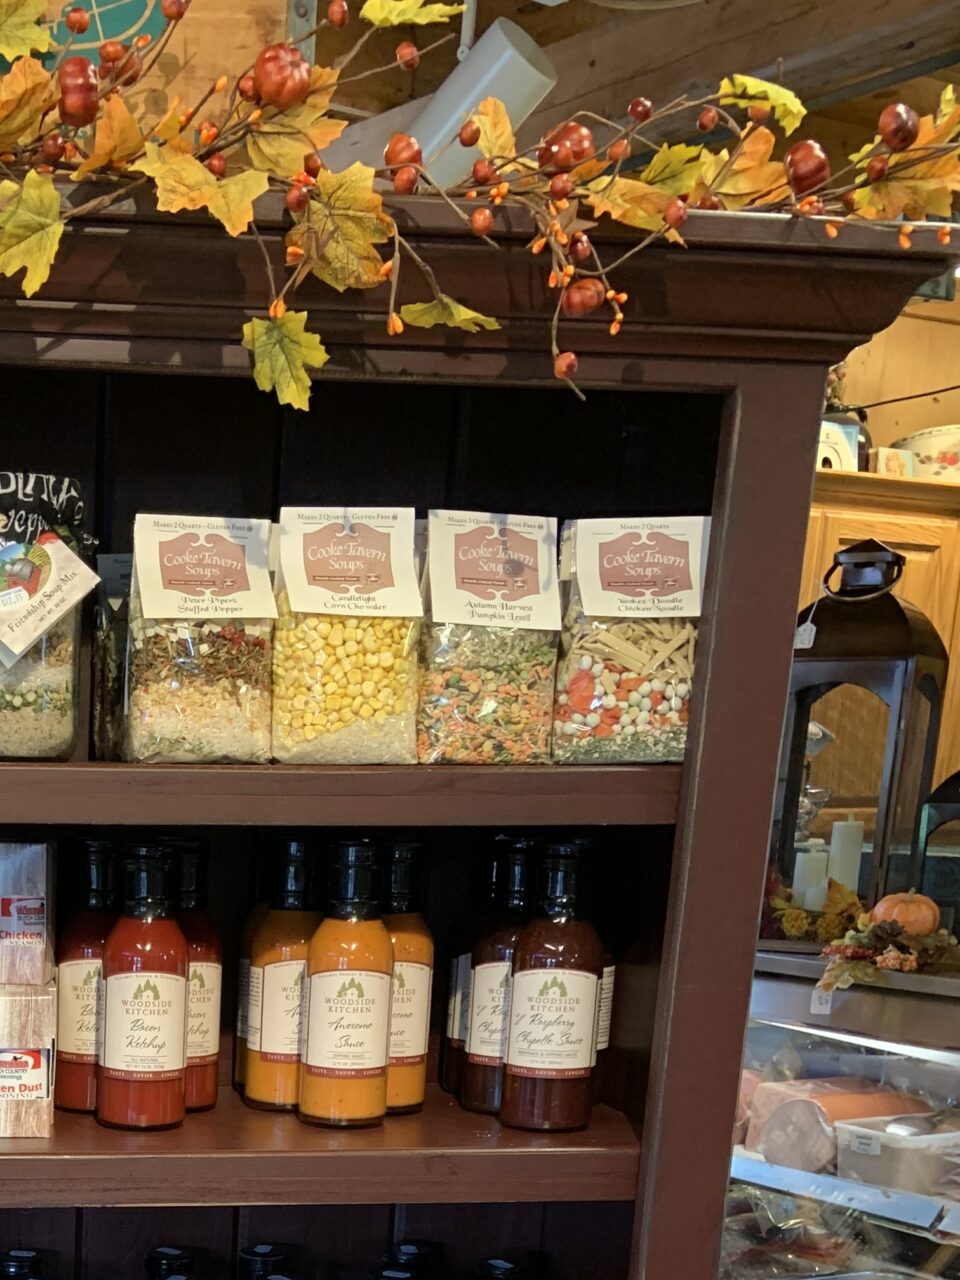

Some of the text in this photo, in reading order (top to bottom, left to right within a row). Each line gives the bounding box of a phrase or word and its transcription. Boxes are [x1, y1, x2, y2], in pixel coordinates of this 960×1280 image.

[308, 539, 387, 561] Cooke Tavern
[164, 548, 242, 570] Cooke Tavern
[604, 547, 685, 568] Cooke Tavern
[185, 566, 220, 580] Soups
[329, 558, 364, 575] Soups
[478, 560, 513, 578] Soups
[625, 565, 661, 581] Soups
[7, 596, 45, 632] Friendship
[42, 584, 63, 602] Soup
[62, 570, 78, 588] Mix
[464, 600, 533, 611] Autumn Harvest
[468, 610, 505, 620] Pumpkin
[0, 930, 41, 939] Chicken
[527, 996, 580, 1004] WOODSIDE
[130, 1019, 160, 1032] Bacon
[328, 1017, 373, 1031] Awesome
[126, 1035, 166, 1054] Ketchup
[335, 1035, 365, 1048] Sauce
[556, 1033, 583, 1045] Sauce
